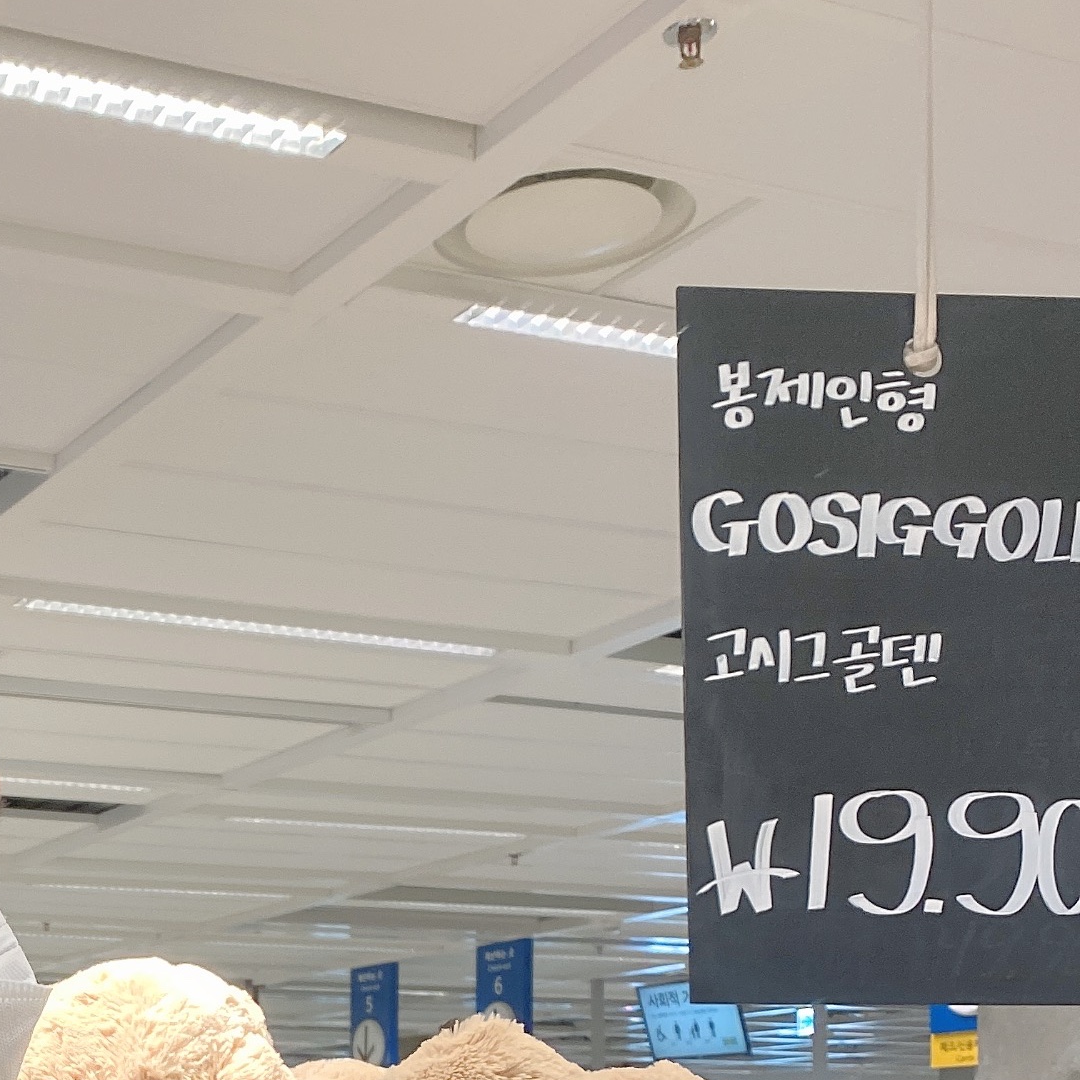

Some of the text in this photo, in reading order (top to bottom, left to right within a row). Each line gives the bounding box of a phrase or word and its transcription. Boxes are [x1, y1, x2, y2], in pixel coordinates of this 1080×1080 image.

[711, 360, 937, 433] 봉제인형
[691, 489, 1080, 563] GOSIGGOL
[703, 625, 944, 694] 고시그골덴
[494, 975, 503, 996] 6
